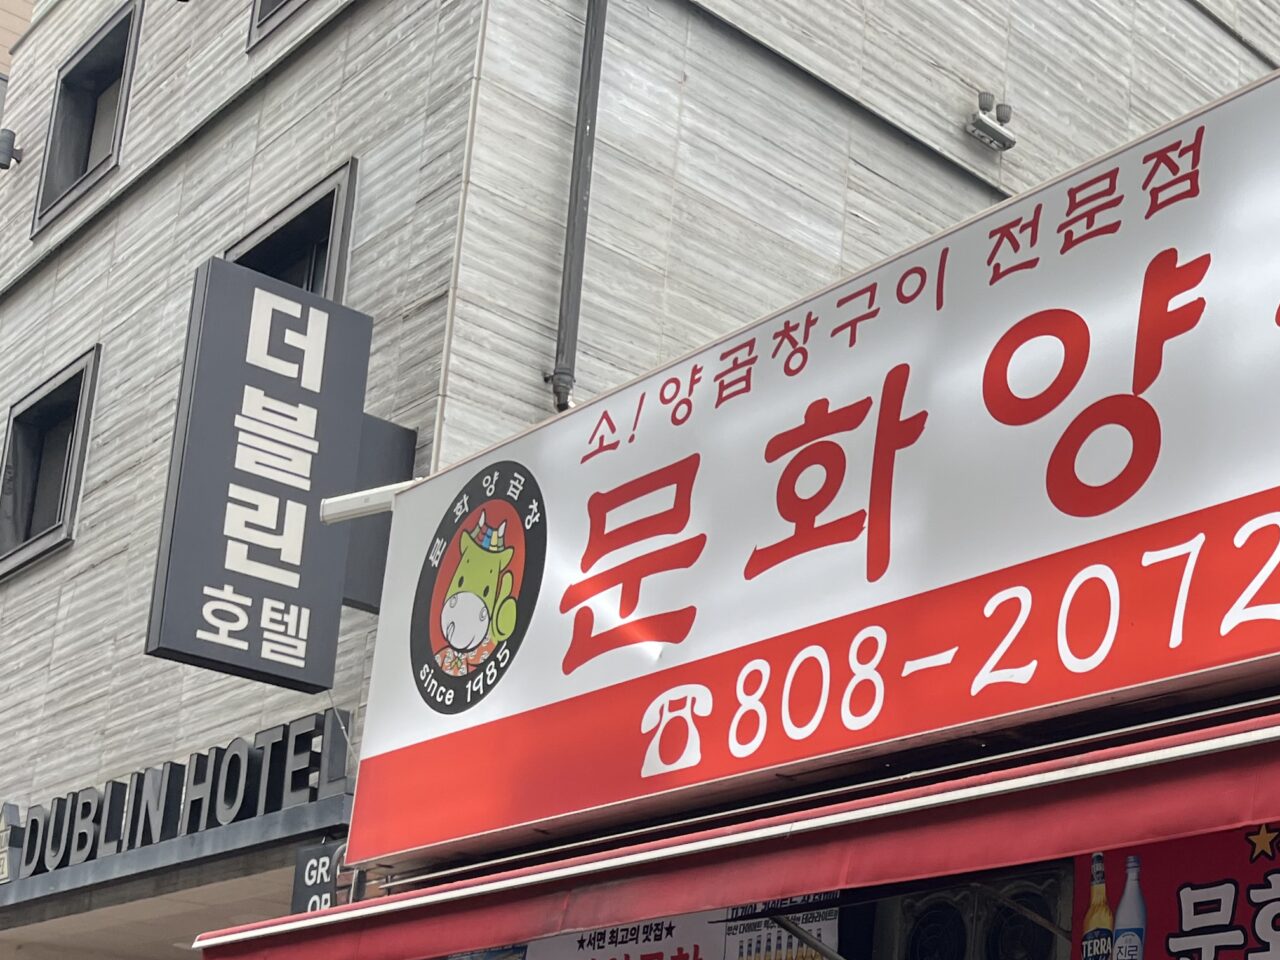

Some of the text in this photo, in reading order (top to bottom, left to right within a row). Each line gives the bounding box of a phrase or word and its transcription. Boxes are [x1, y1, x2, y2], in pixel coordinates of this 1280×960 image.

[986, 125, 1207, 288] 전문점
[222, 286, 330, 590] 더블린
[428, 467, 543, 568] 문화양곱창
[196, 583, 312, 670] 호텔
[465, 642, 512, 704] 1985
[19, 708, 350, 880] DUBLIN HOTEL
[586, 920, 664, 951] 서면 최고의 맛집
[1082, 936, 1112, 959] TERRA
